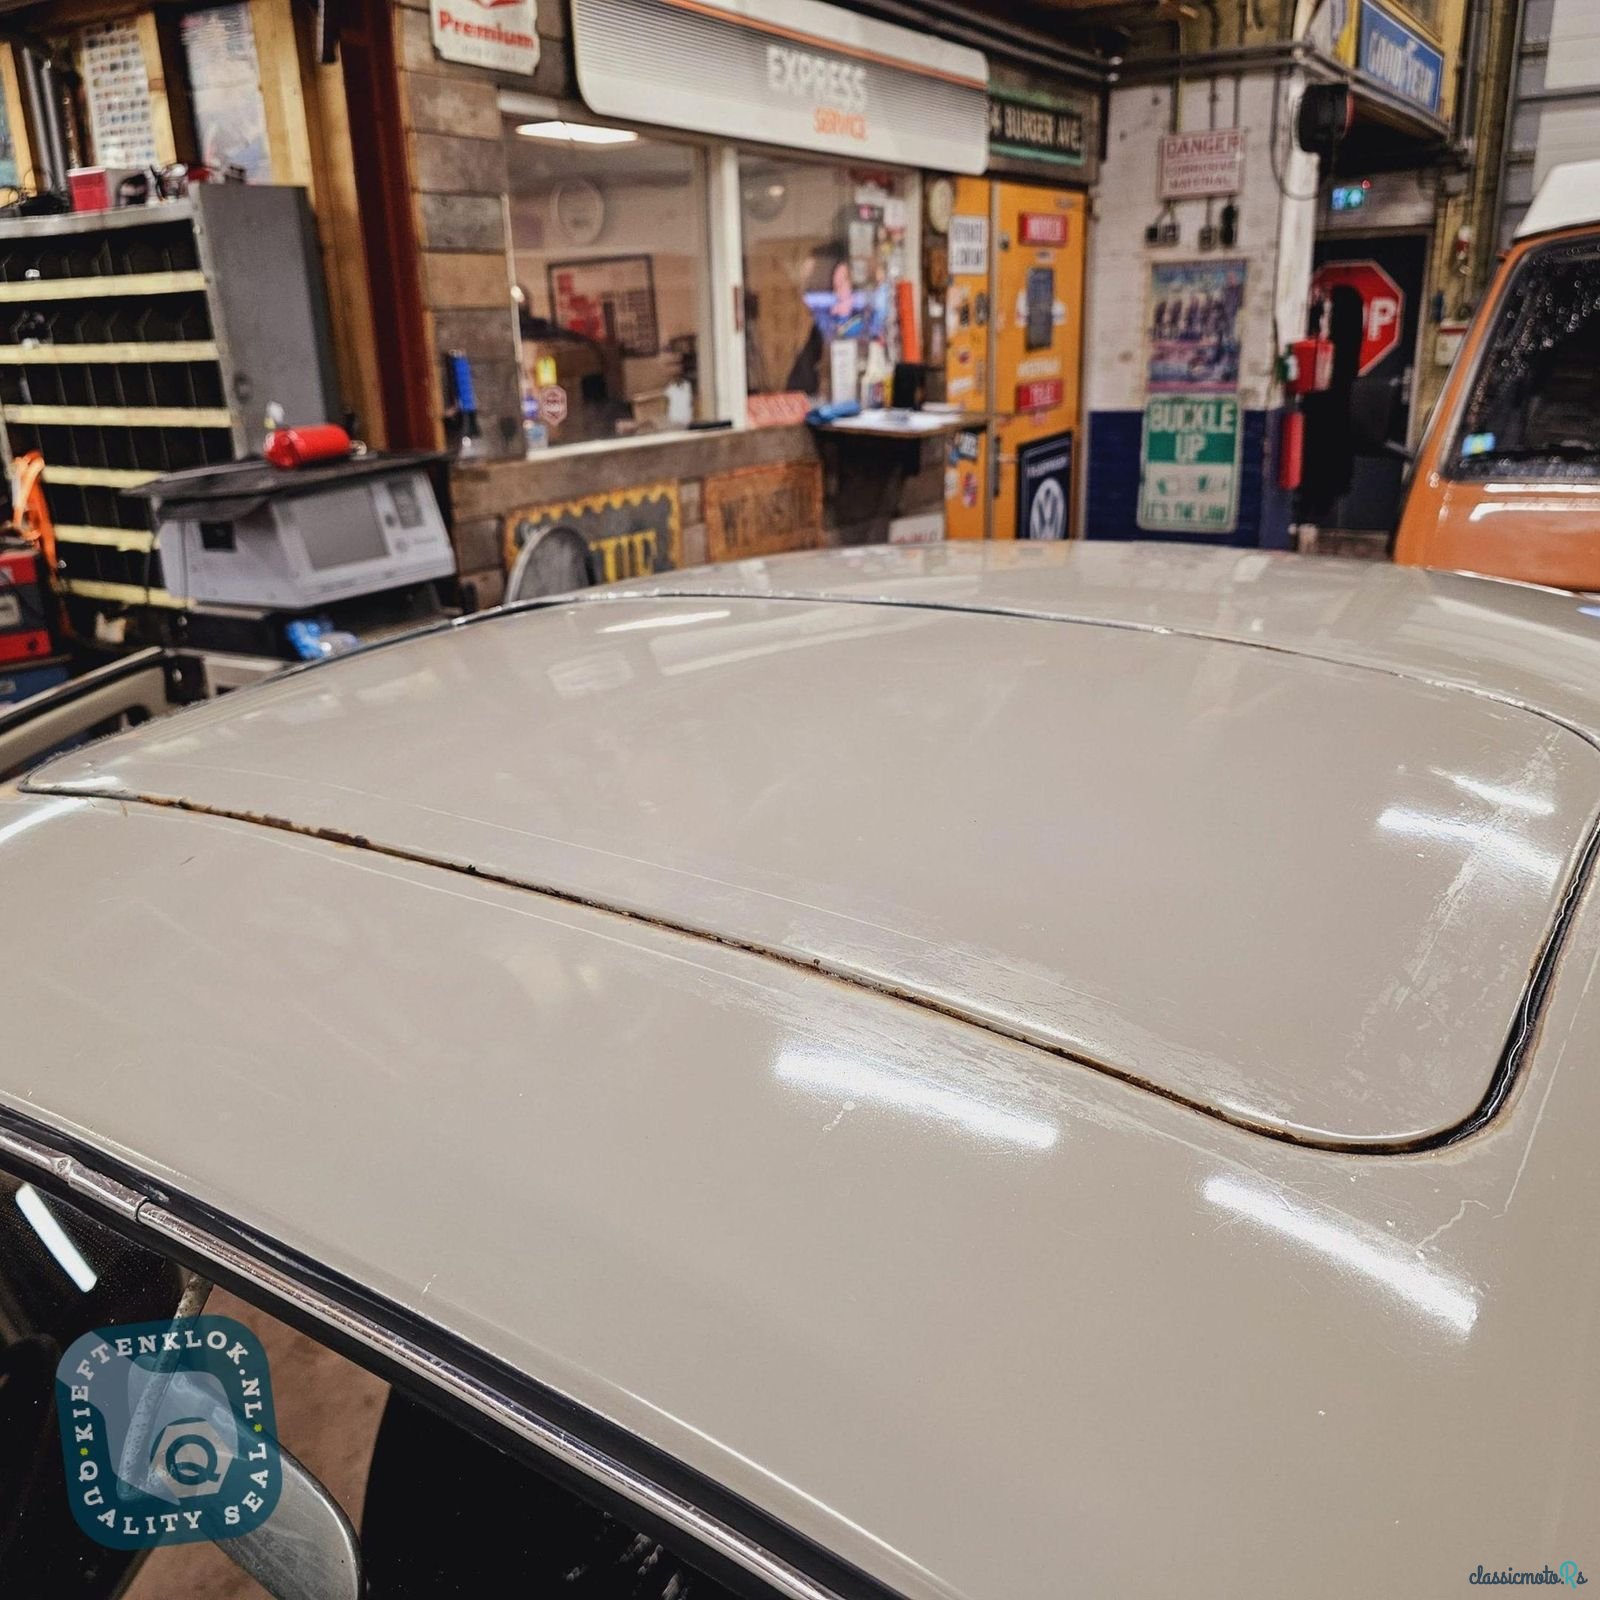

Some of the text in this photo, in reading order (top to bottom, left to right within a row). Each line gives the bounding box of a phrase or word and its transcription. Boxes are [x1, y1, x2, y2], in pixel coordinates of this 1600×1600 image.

[438, 9, 535, 49] Premium
[766, 45, 867, 112] EXPRESS
[1167, 135, 1239, 159] DANGER
[1149, 402, 1236, 433] BUCKLE
[1175, 433, 1207, 463] UP
